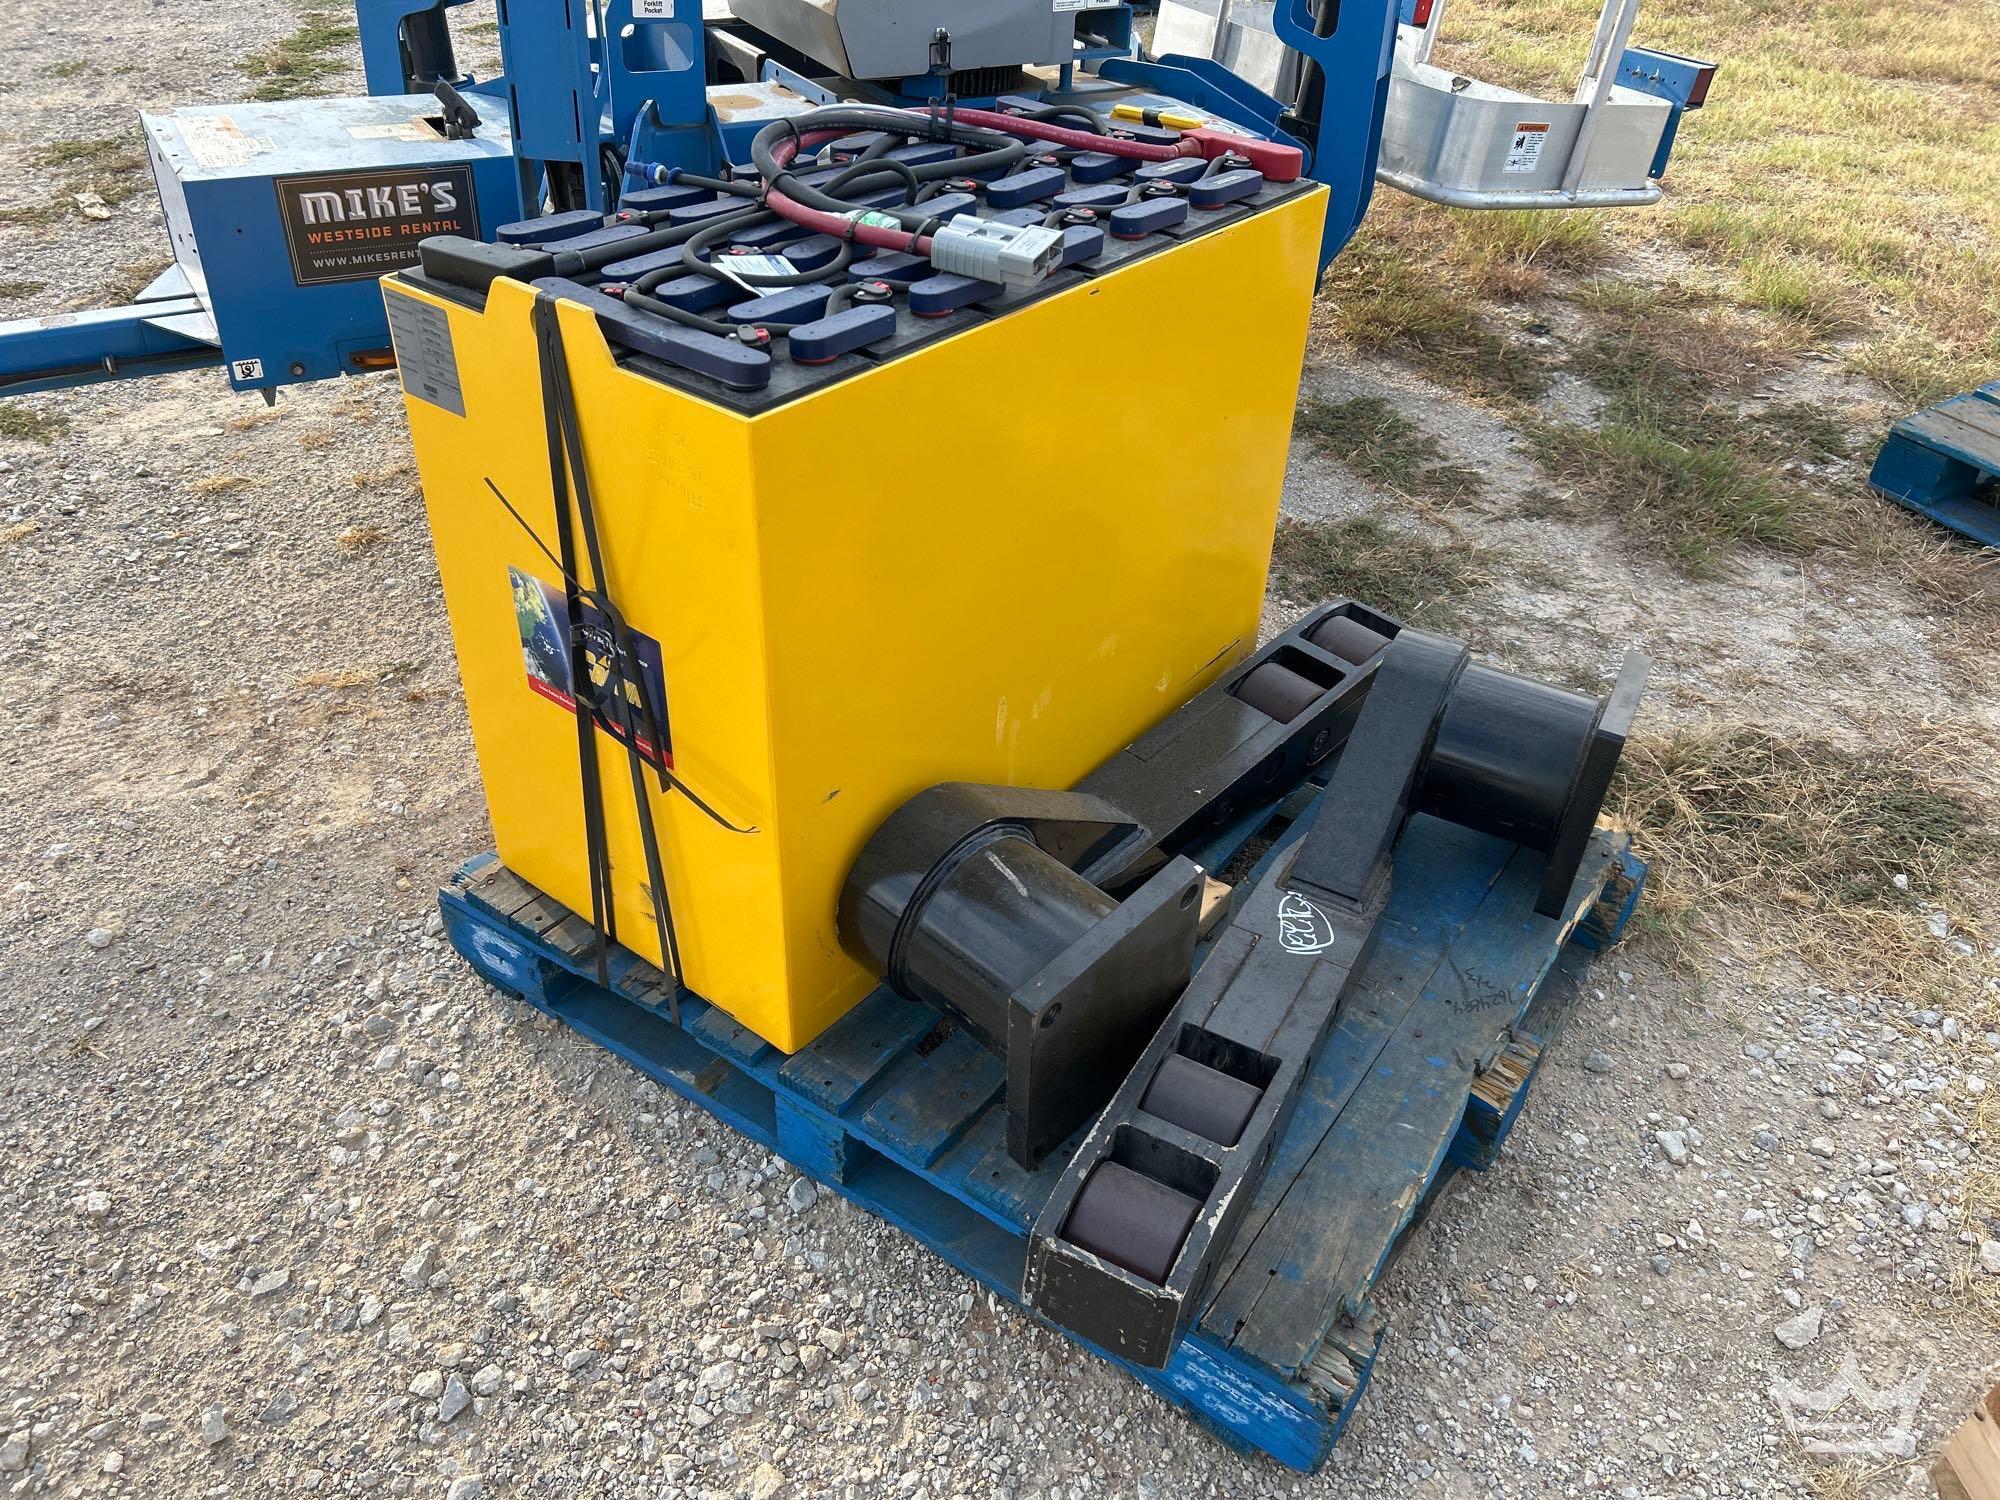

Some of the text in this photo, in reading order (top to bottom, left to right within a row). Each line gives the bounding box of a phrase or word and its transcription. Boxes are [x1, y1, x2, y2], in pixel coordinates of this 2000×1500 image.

[298, 181, 458, 225] MIKE'S
[306, 220, 461, 244] WESTSIDE RENTAL
